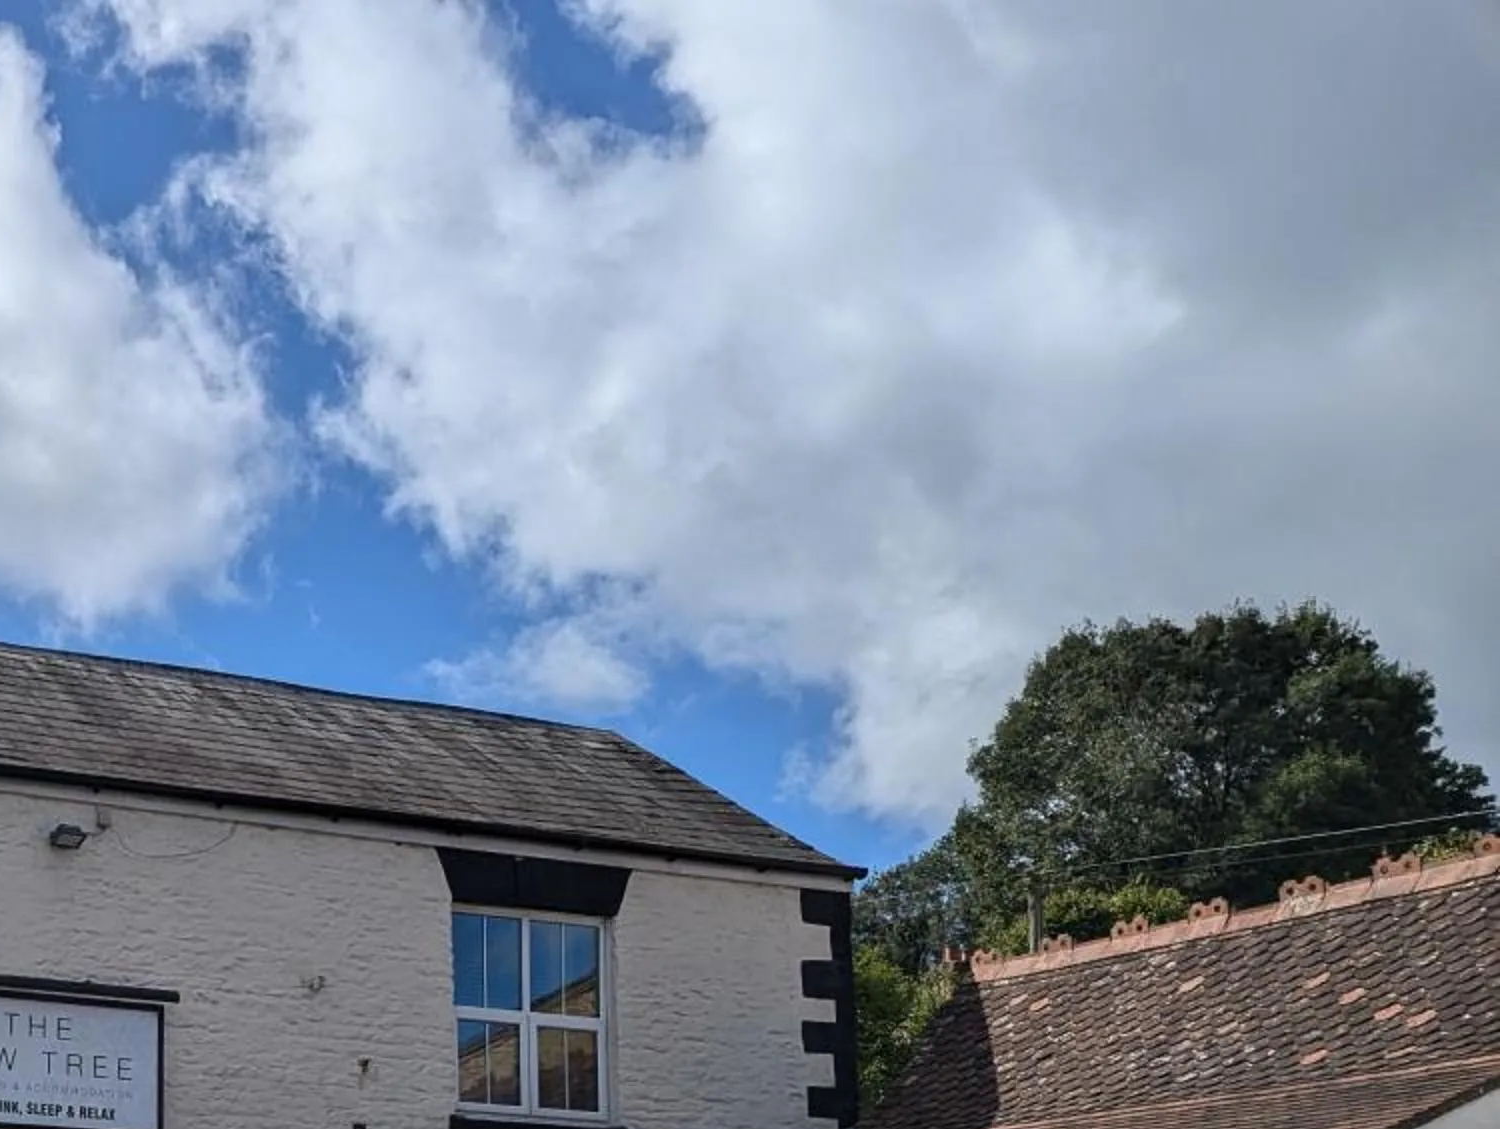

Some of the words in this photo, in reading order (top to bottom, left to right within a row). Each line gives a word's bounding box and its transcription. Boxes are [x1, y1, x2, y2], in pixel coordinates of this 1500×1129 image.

[5, 1012, 73, 1041] THE
[42, 1051, 133, 1081] TREE
[26, 1102, 63, 1118] SLEEP
[66, 1105, 76, 1119] &
[79, 1106, 116, 1121] RELAX
